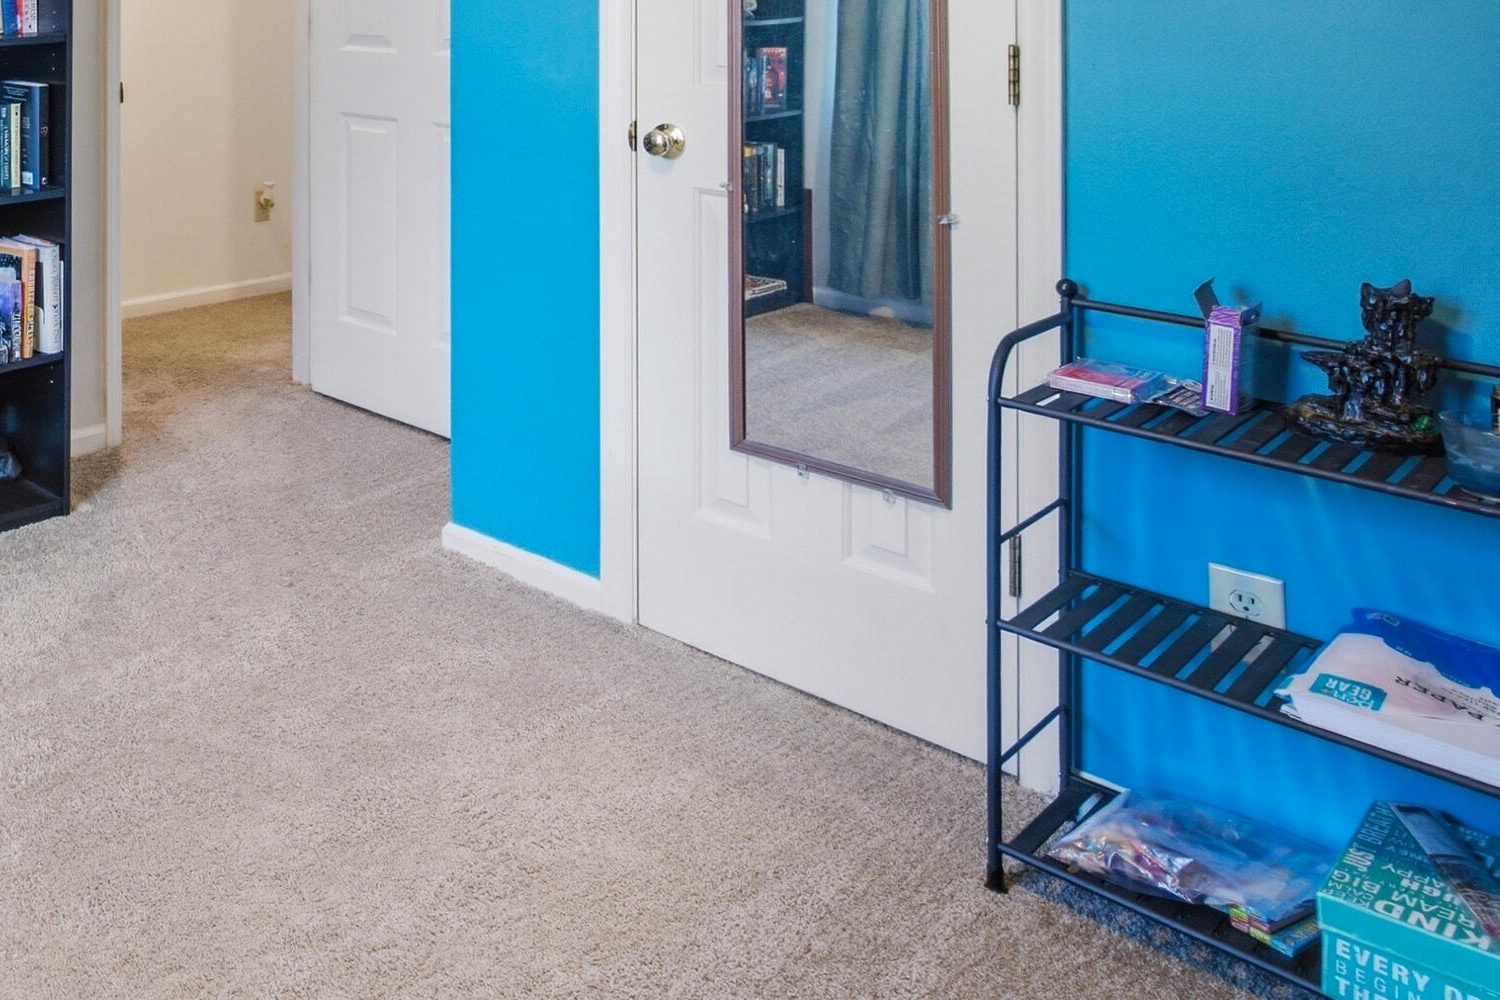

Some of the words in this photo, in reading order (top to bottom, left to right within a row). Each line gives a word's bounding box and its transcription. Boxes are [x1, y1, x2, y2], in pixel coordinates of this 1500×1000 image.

[1326, 678, 1373, 699] GEAR
[1394, 676, 1486, 720] PAPER
[1331, 869, 1381, 895] BIG
[1374, 900, 1493, 951] KIND
[1336, 938, 1430, 992] EVERY
